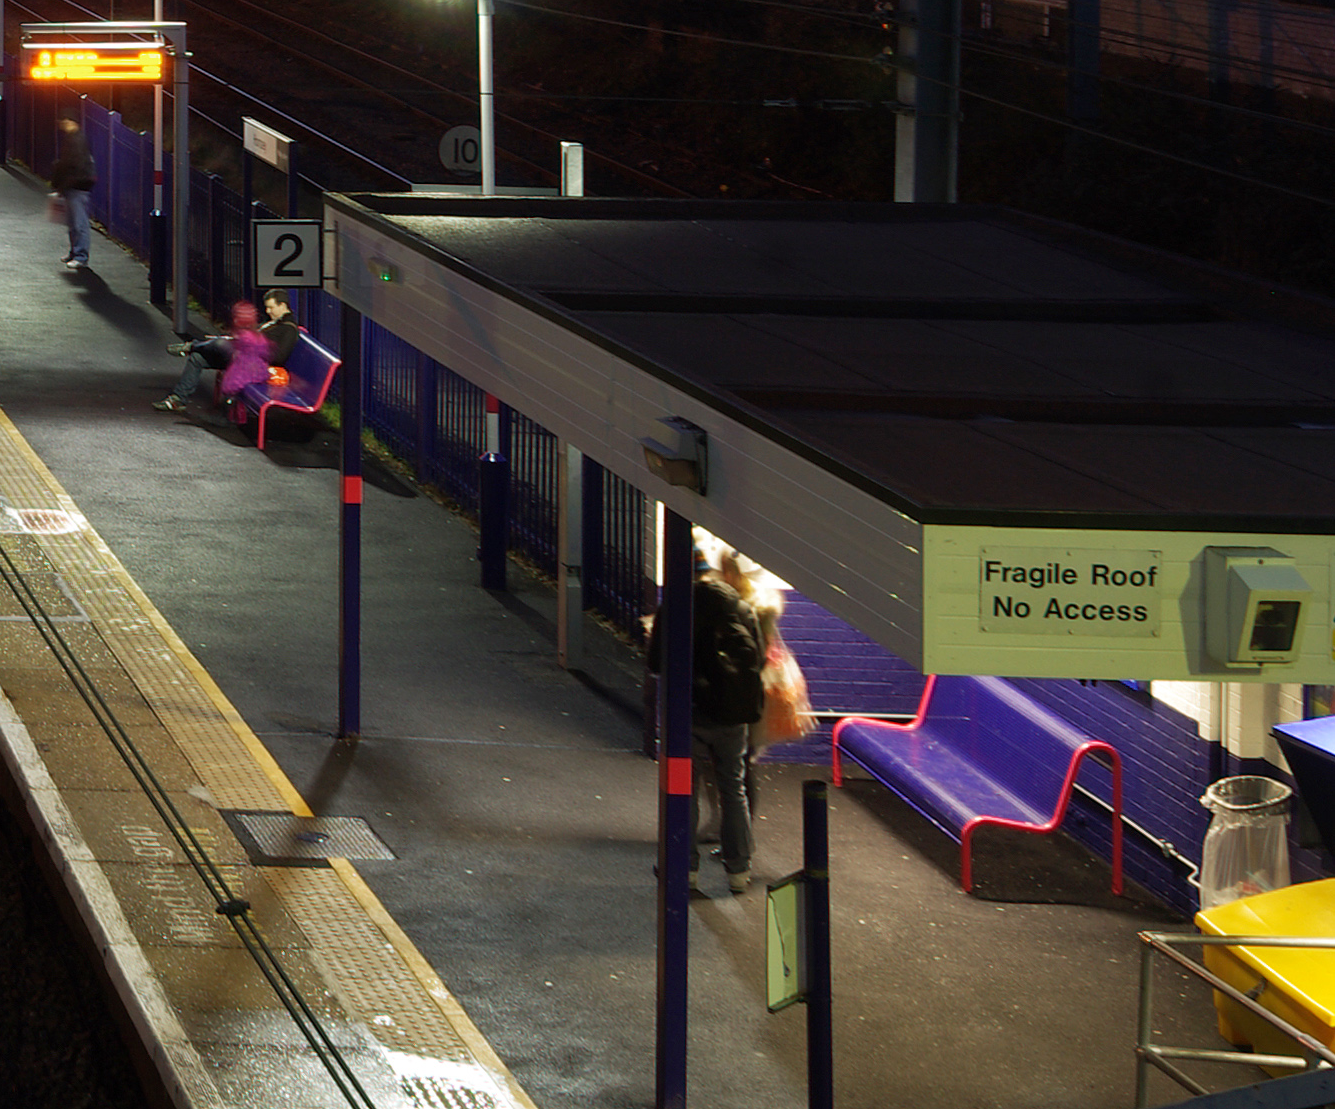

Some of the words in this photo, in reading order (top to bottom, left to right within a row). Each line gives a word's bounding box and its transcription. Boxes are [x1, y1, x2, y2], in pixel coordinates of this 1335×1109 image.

[453, 138, 478, 163] 10
[273, 233, 303, 277] 2
[985, 561, 1078, 589] Fragile
[1090, 564, 1158, 587] Roof
[992, 596, 1031, 618] No
[1043, 598, 1148, 622] Access
[121, 824, 174, 858] gap
